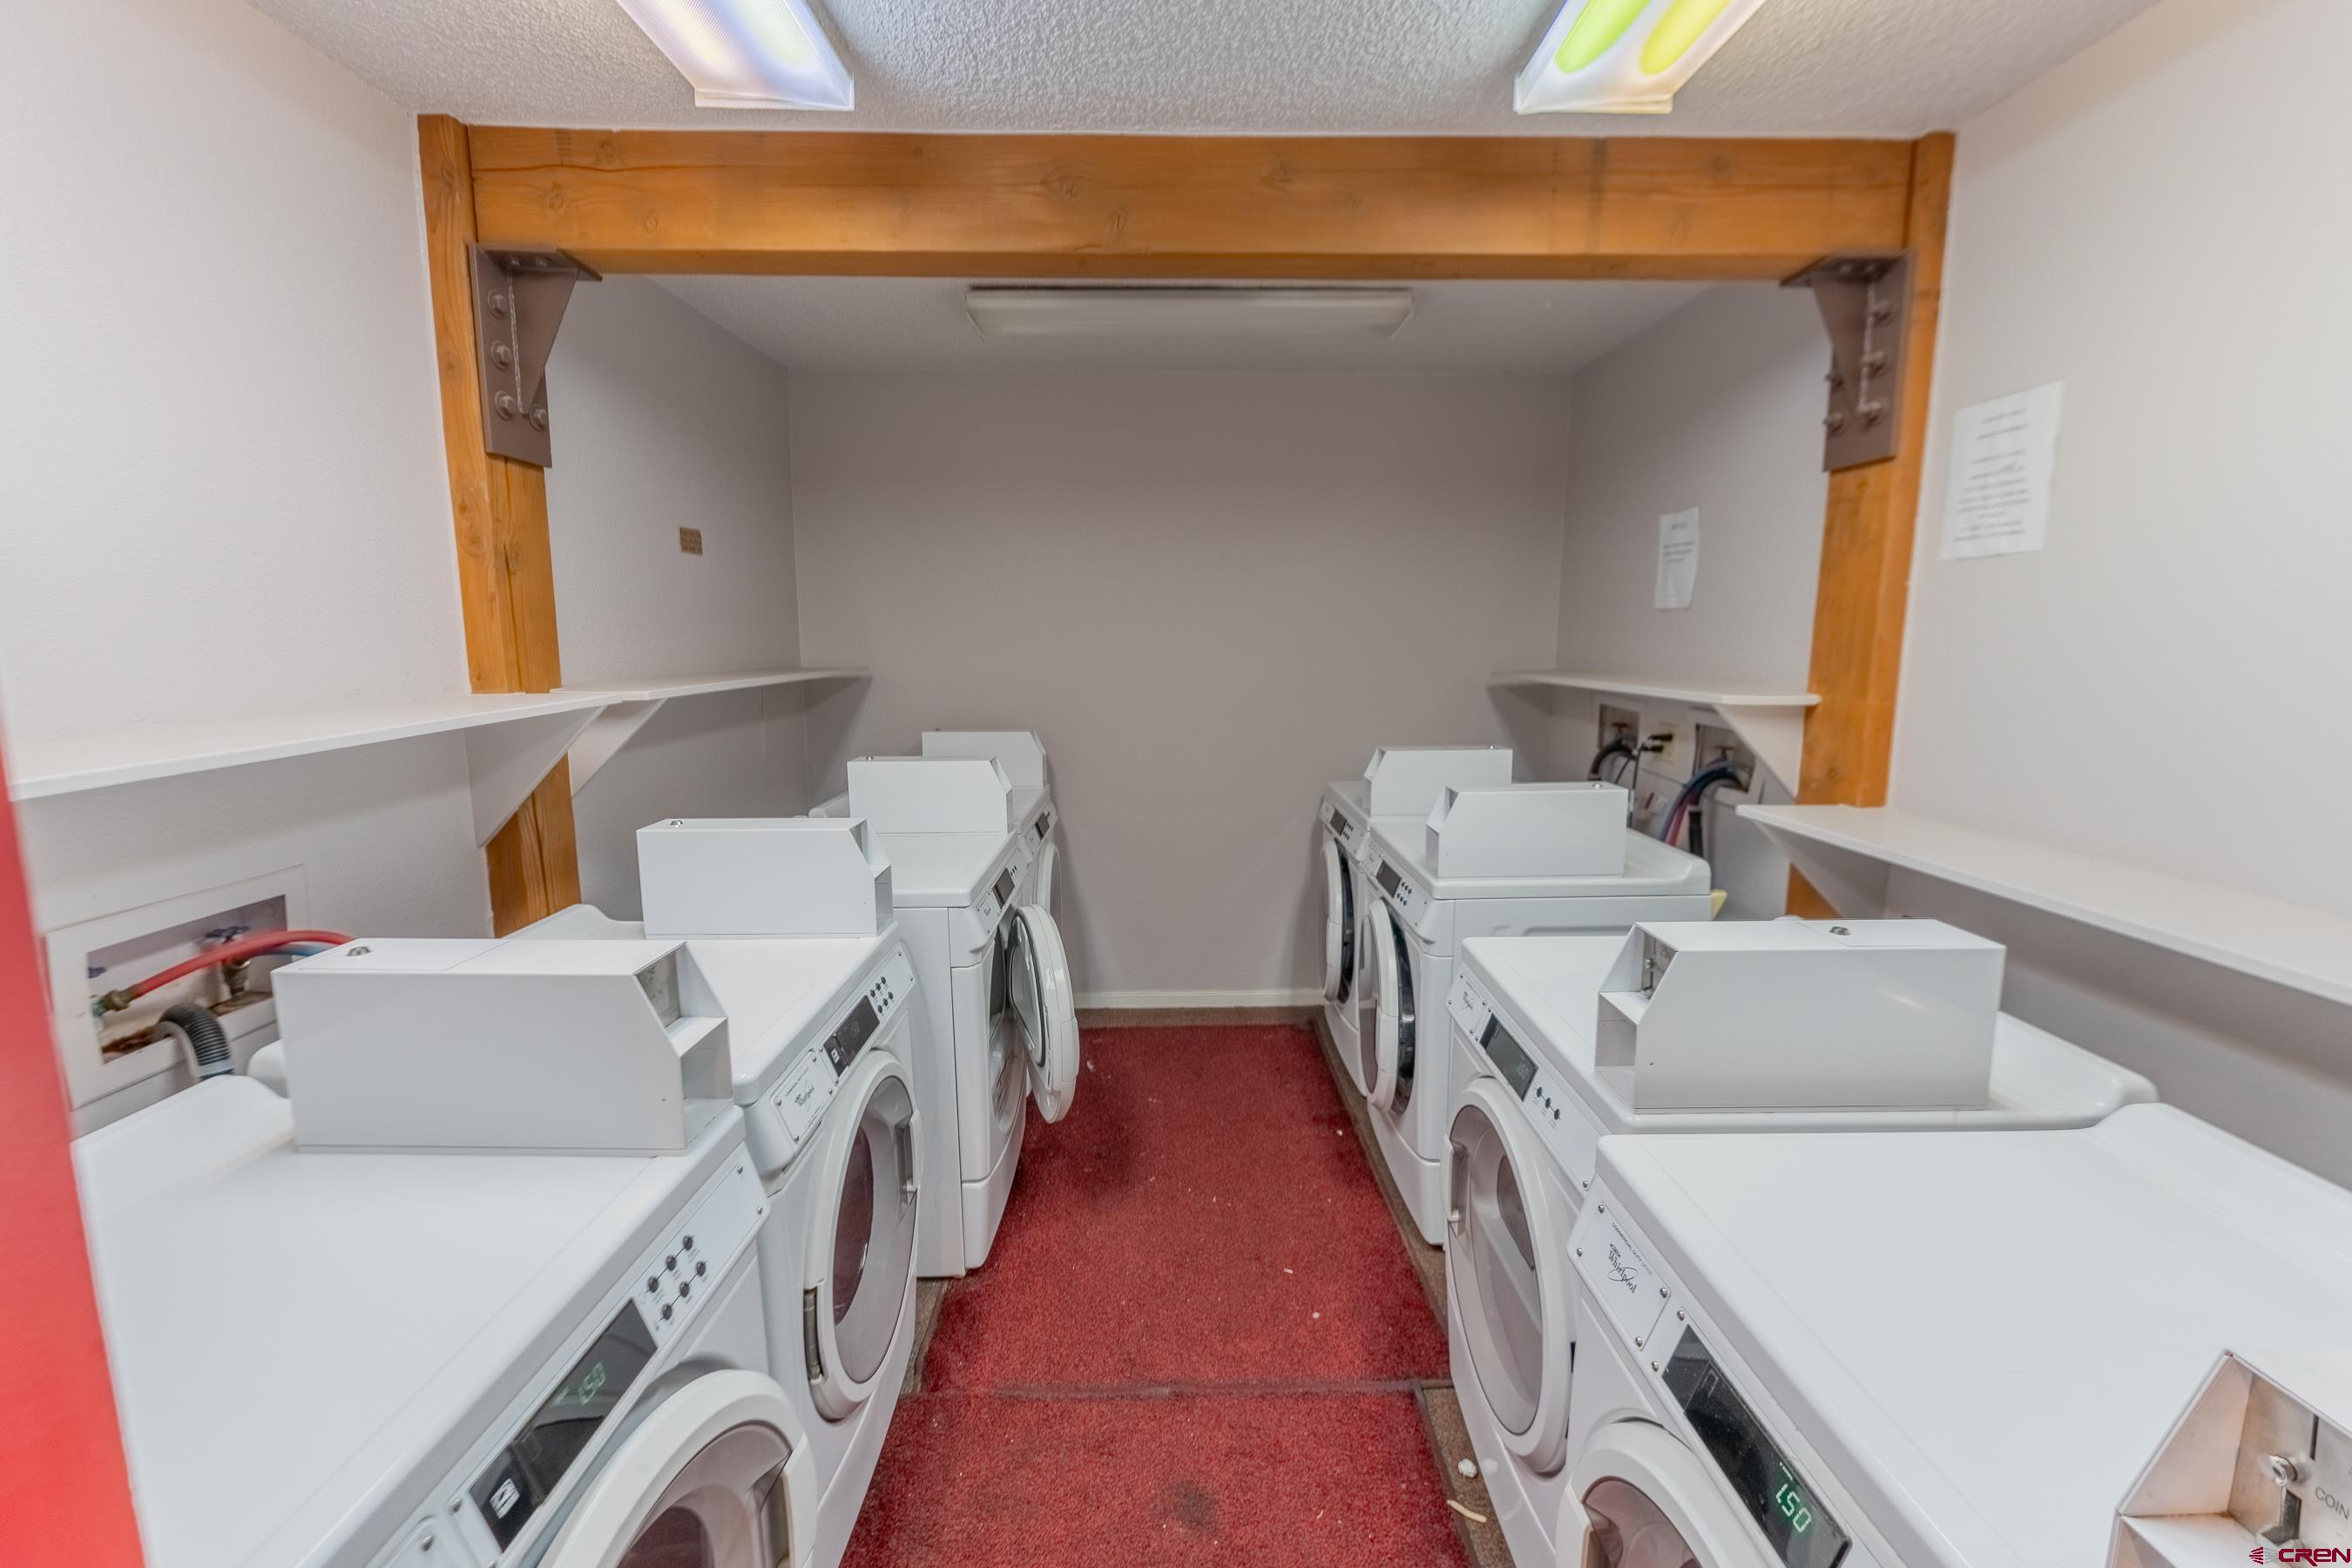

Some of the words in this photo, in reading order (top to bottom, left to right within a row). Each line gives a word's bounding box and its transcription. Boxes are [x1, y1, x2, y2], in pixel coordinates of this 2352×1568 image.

[1609, 1250, 1638, 1293] Whirlpool
[1776, 1484, 1812, 1532] 1.50
[2315, 1486, 2350, 1520] COIN
